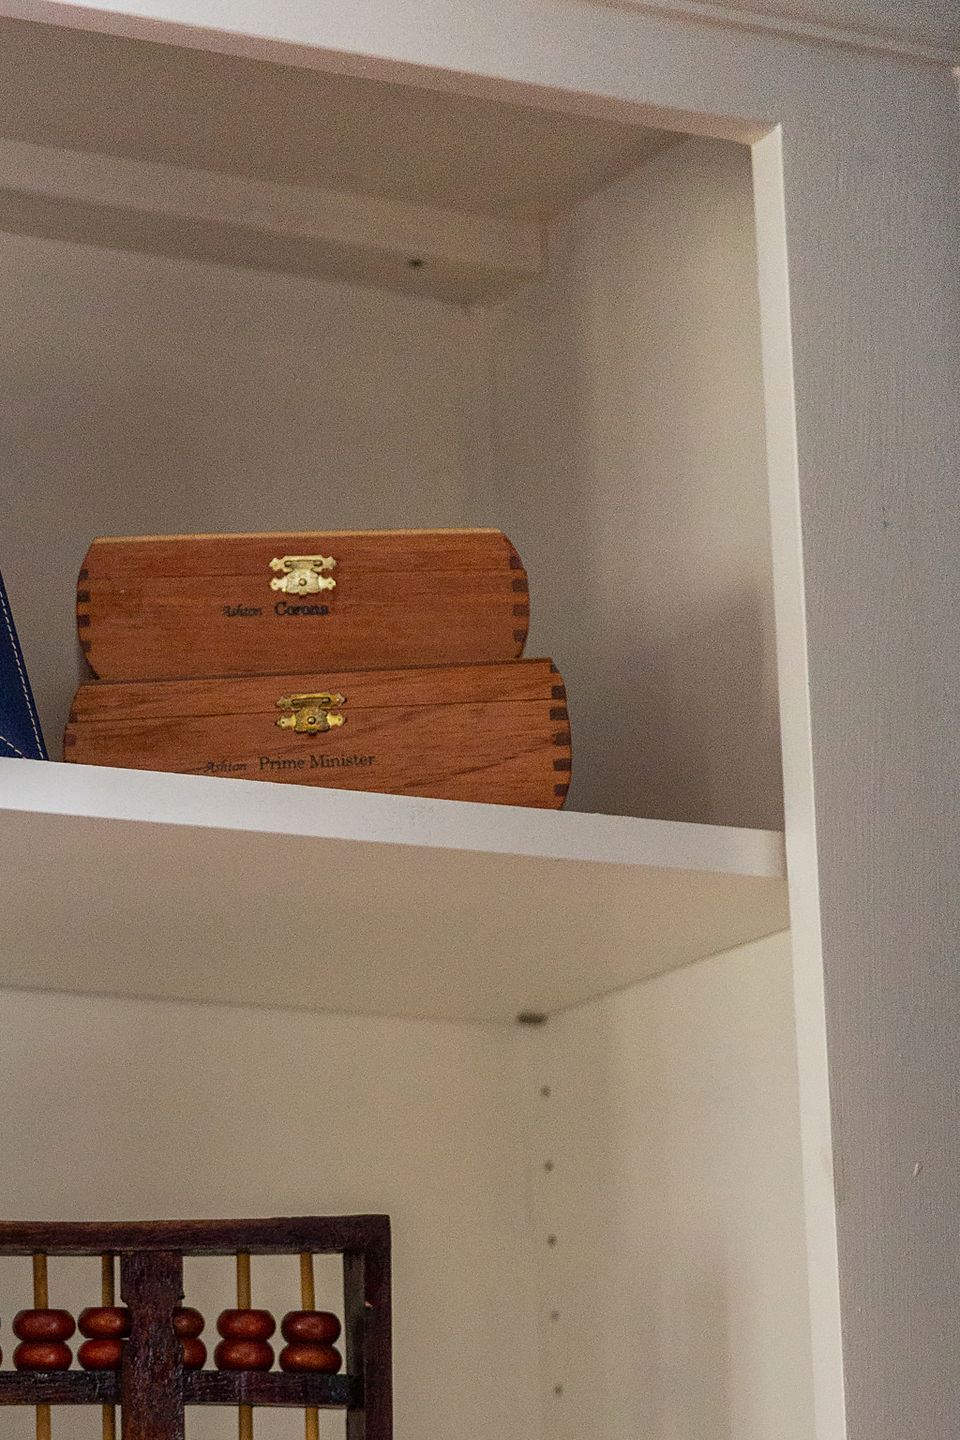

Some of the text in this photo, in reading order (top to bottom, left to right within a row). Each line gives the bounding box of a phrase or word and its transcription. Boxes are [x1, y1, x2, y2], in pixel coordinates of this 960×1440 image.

[274, 601, 329, 616] Corona
[258, 756, 304, 770] Prime
[310, 754, 375, 769] Minister
